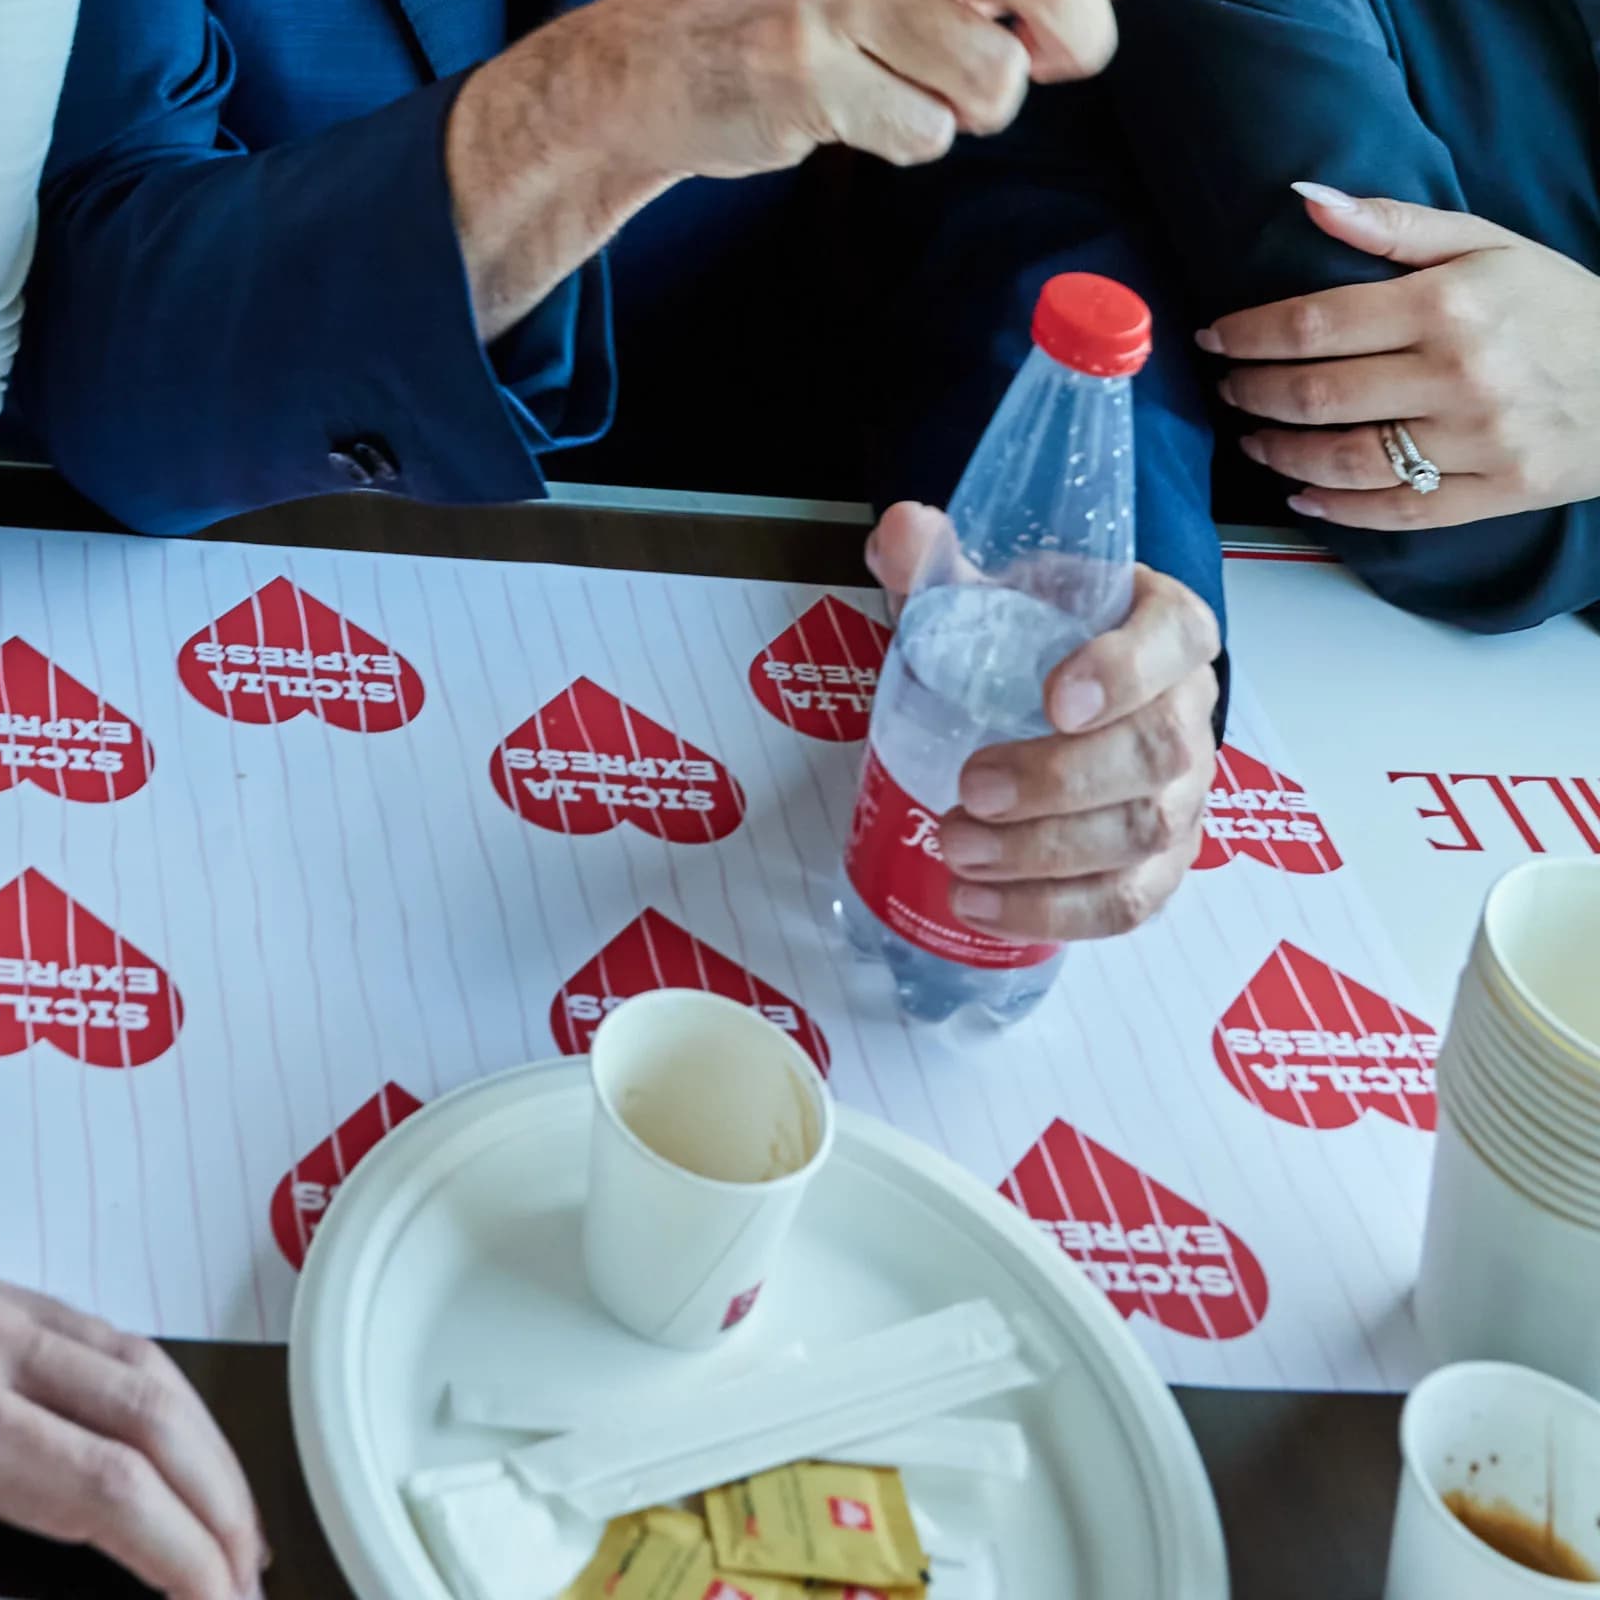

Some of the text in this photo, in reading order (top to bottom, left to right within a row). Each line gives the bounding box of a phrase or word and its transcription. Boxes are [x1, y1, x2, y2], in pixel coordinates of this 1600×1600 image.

[193, 642, 402, 676] EXPRESS
[762, 660, 879, 686] RESS
[207, 670, 396, 704] SICILIA
[504, 747, 718, 782] EXPRESS
[521, 777, 716, 812] SICILIA
